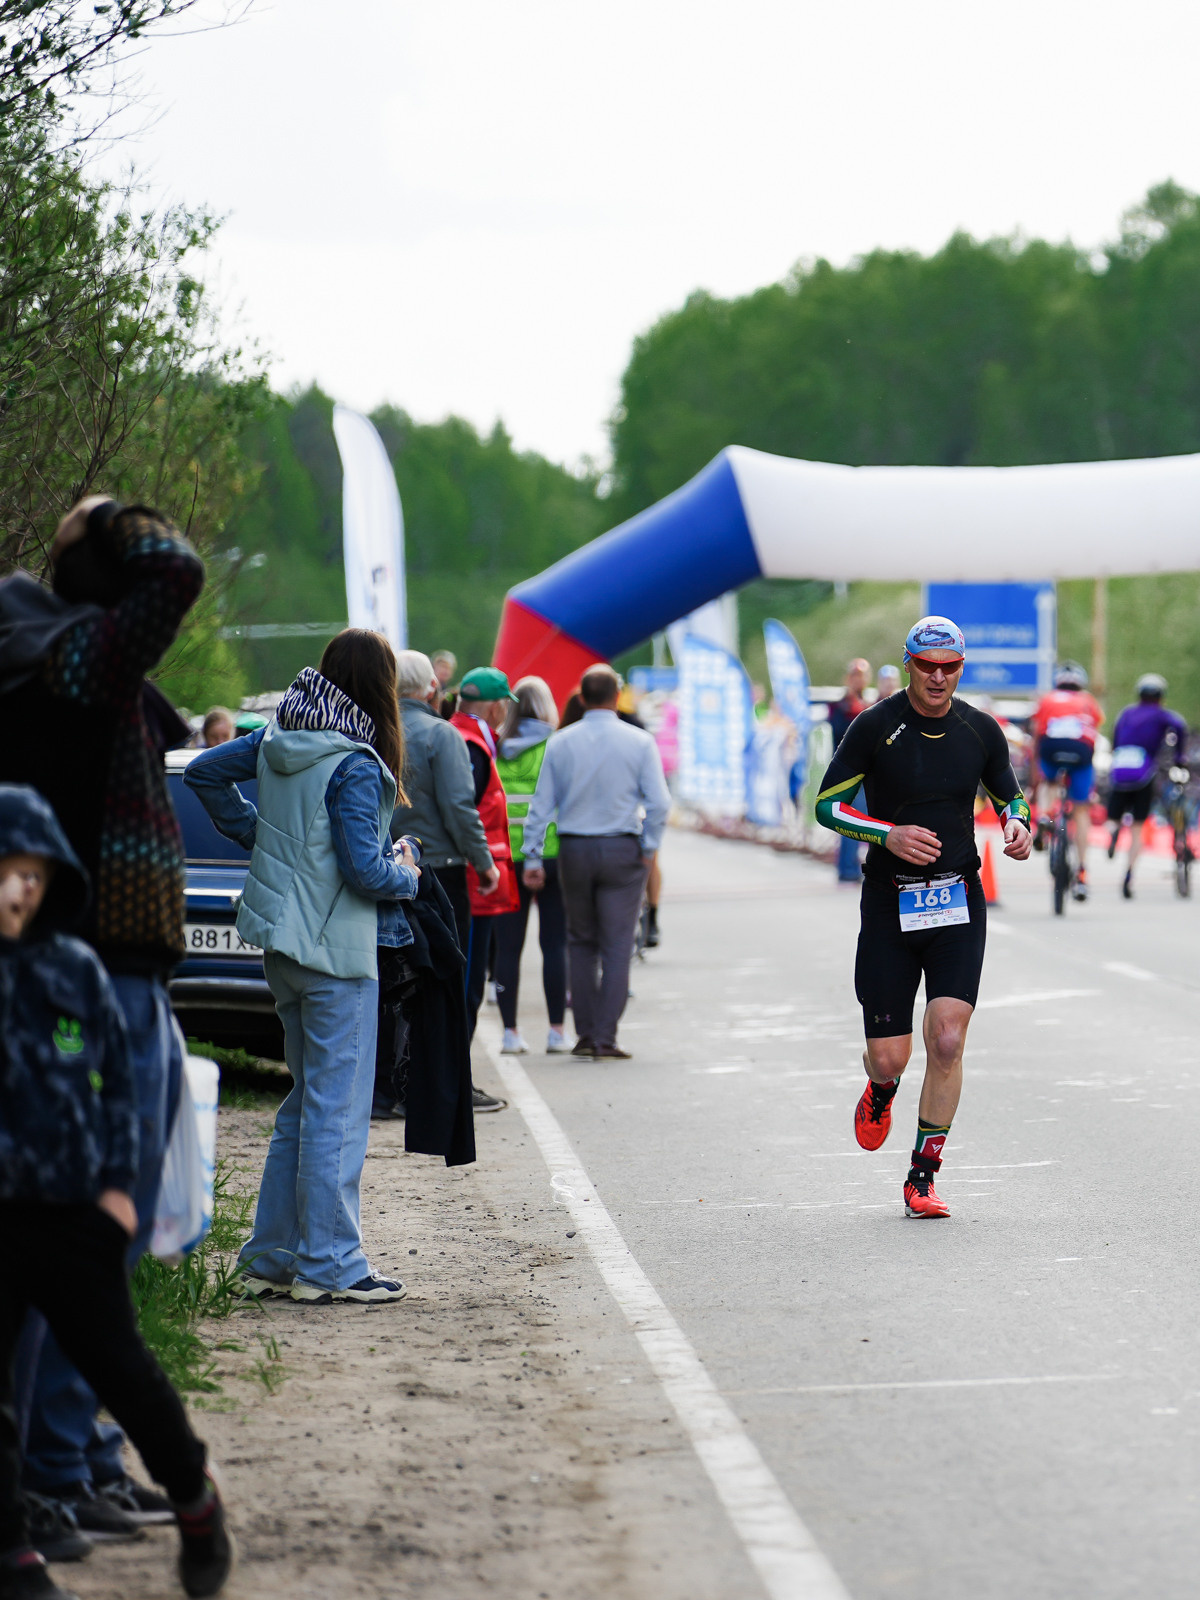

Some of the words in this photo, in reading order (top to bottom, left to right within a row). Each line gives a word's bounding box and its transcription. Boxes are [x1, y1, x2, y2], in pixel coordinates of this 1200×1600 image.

[834, 825, 860, 840] SOUTH
[859, 832, 882, 846] AFRICA
[914, 887, 952, 908] 168
[182, 928, 261, 950] 881Х
